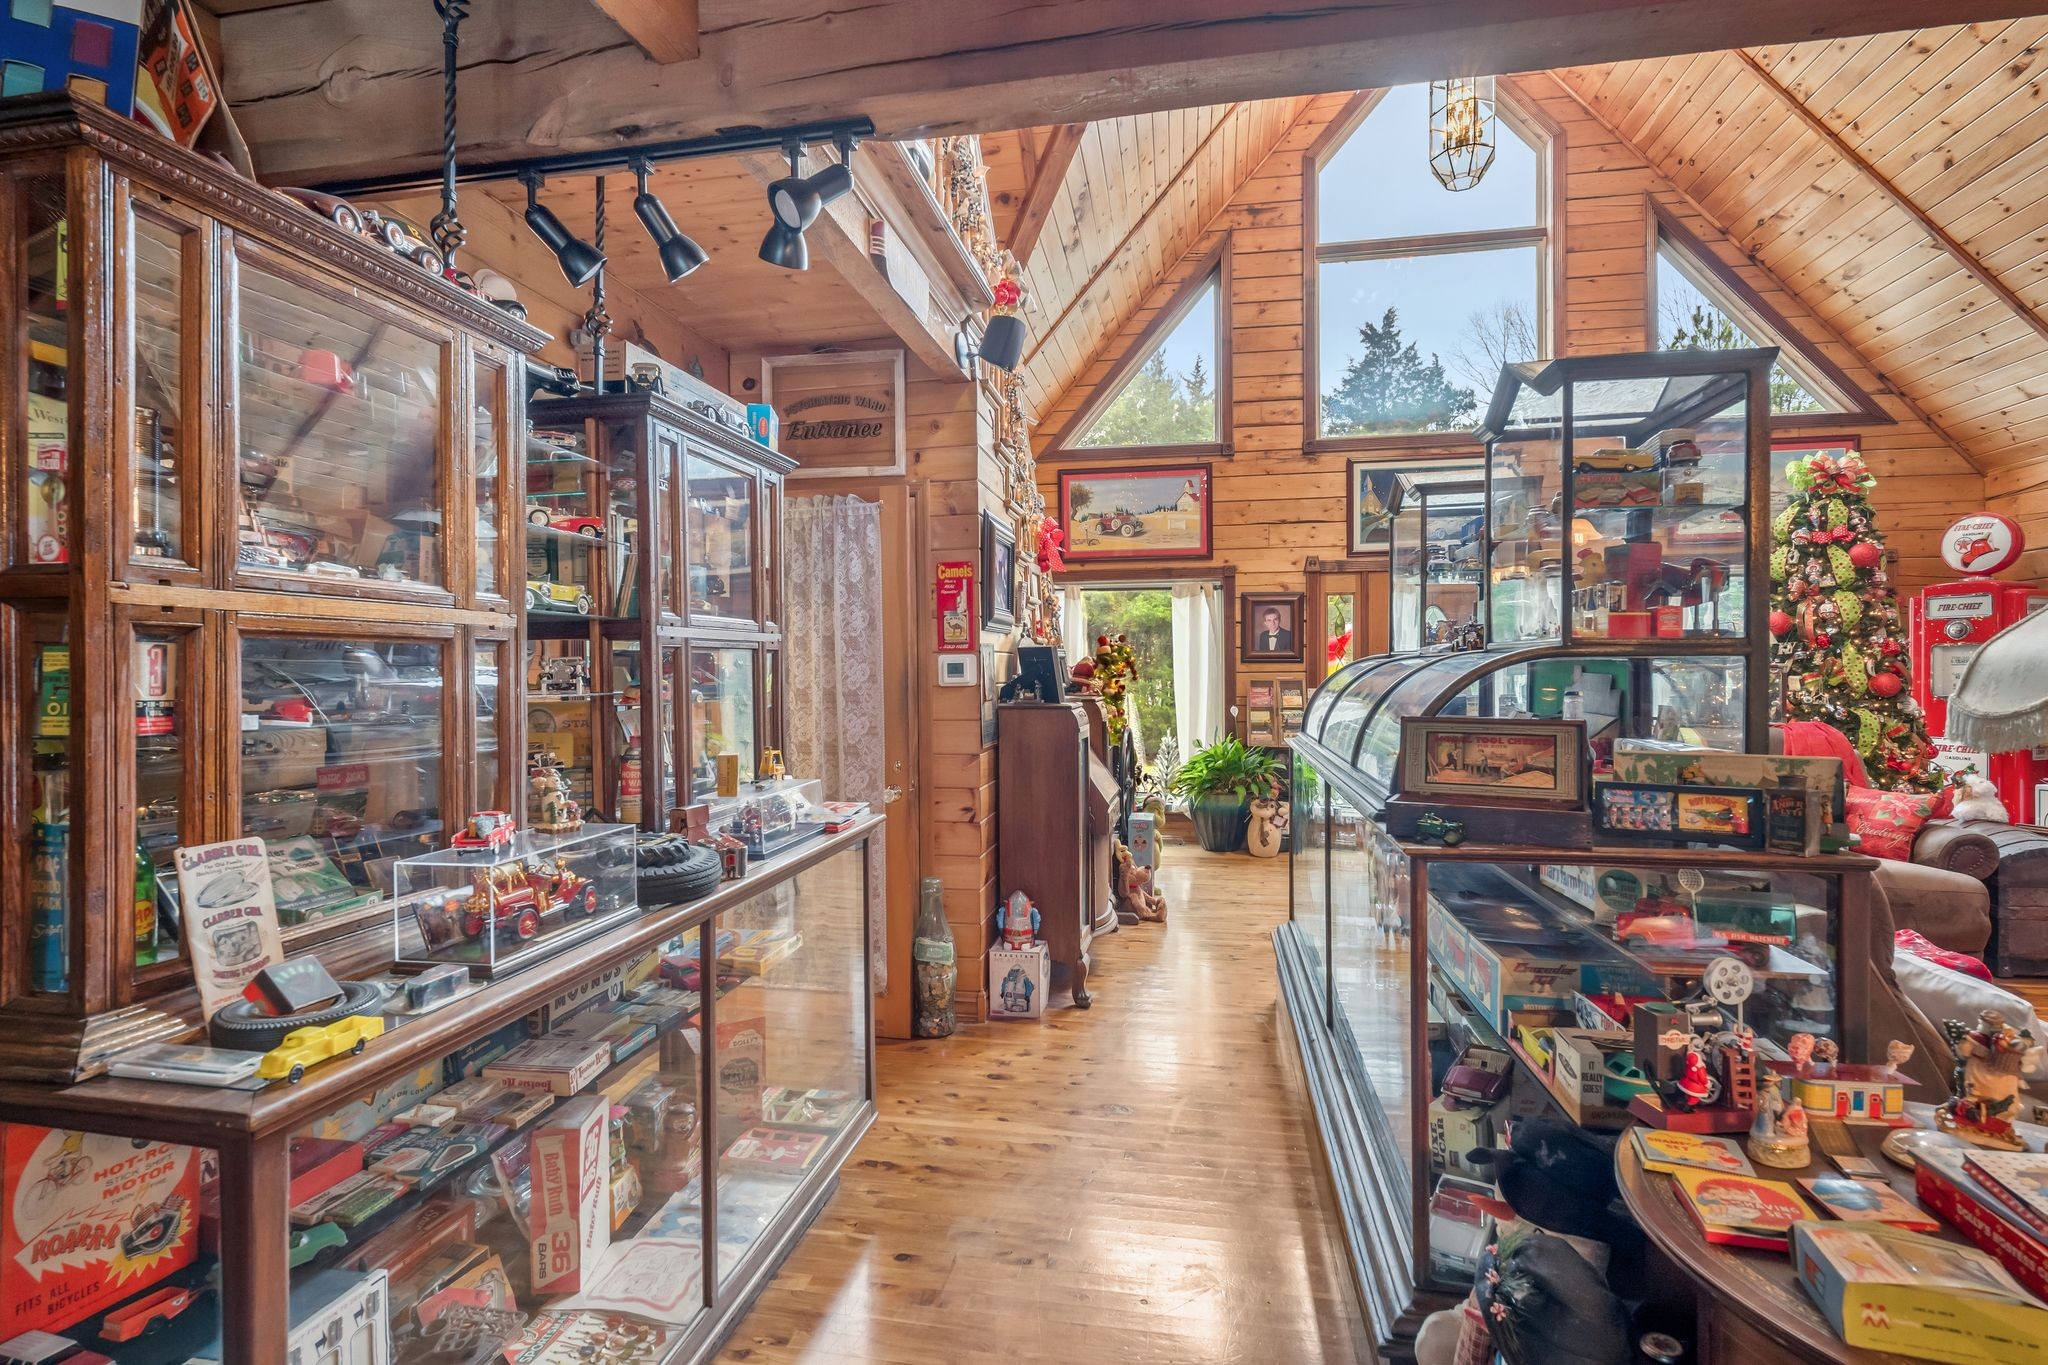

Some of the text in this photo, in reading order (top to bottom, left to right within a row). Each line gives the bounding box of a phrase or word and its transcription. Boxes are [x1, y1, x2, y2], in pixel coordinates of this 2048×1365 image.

[783, 394, 886, 418] PSYCHIATRIC WARD
[786, 420, 882, 441] Entrance
[1953, 522, 1996, 532] FIRE-CHIEF
[937, 564, 973, 579] Camels
[1937, 602, 1983, 612] FIRE-CHIEF
[47, 702, 68, 715] OI
[562, 719, 590, 728] STA
[1475, 736, 1505, 745] TOOL
[1934, 744, 1981, 755] FIRE-CHIE
[621, 771, 641, 780] HORN
[1856, 822, 1910, 849] Greetings
[182, 847, 233, 871] CLABBER
[236, 844, 263, 857] GIRL
[202, 906, 263, 929] CLABBER GIRL
[1730, 932, 1748, 941] FISH
[1749, 934, 1787, 944] HATCHERY
[1513, 961, 1578, 975] Crusader
[554, 963, 621, 1011] MOUNDS
[1588, 1060, 1596, 1070] IT
[518, 1078, 554, 1094] Tootsie
[1581, 1073, 1602, 1083] REALLY
[1582, 1083, 1602, 1094] GOES!
[1665, 1144, 1689, 1152] SET
[93, 1142, 172, 1182] HOT-RO
[102, 1160, 175, 1200] MOTOR
[544, 1152, 565, 1216] Baby Ruth
[1738, 1198, 1801, 1214] SHAVING
[1765, 1210, 1794, 1221] SET
[1955, 1203, 2036, 1272] DOLLY'S HOSTESS
[538, 1242, 547, 1279] BARS
[551, 1231, 571, 1274] 36
[15, 1282, 71, 1317] FITS ALL
[48, 1281, 101, 1315] BICYCLES
